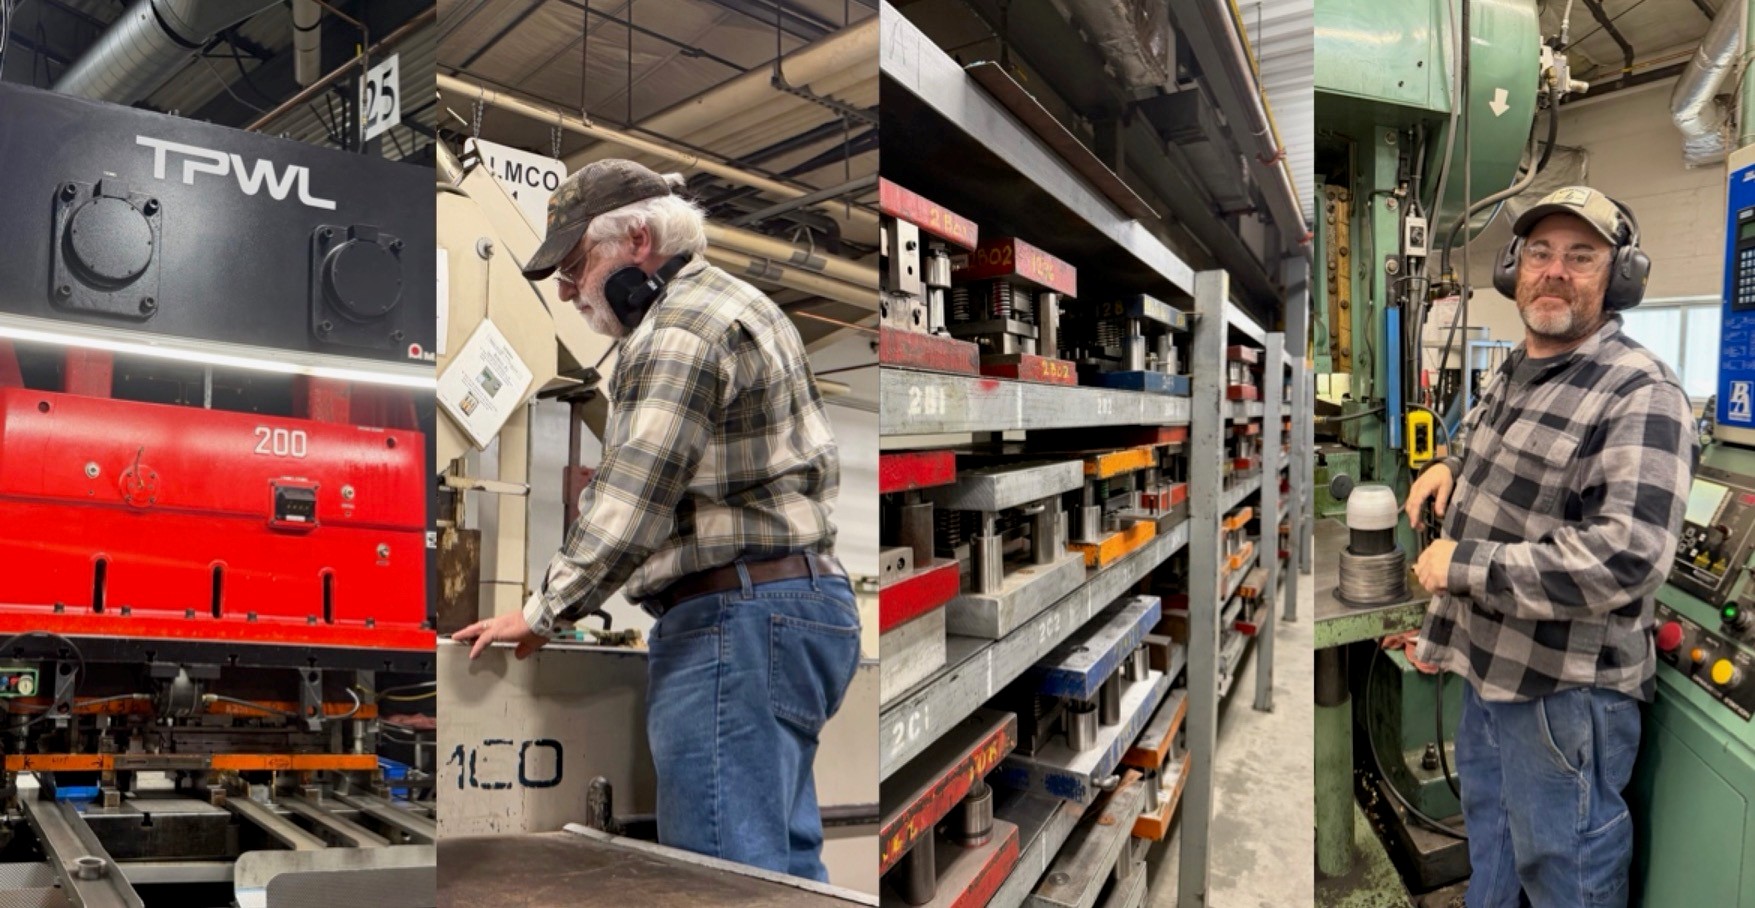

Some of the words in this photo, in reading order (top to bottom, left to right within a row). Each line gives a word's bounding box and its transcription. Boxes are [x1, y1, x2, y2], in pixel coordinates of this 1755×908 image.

[363, 67, 396, 129] 25
[136, 134, 337, 211] TPWL
[254, 425, 308, 459] 200
[890, 705, 930, 757] 2C1
